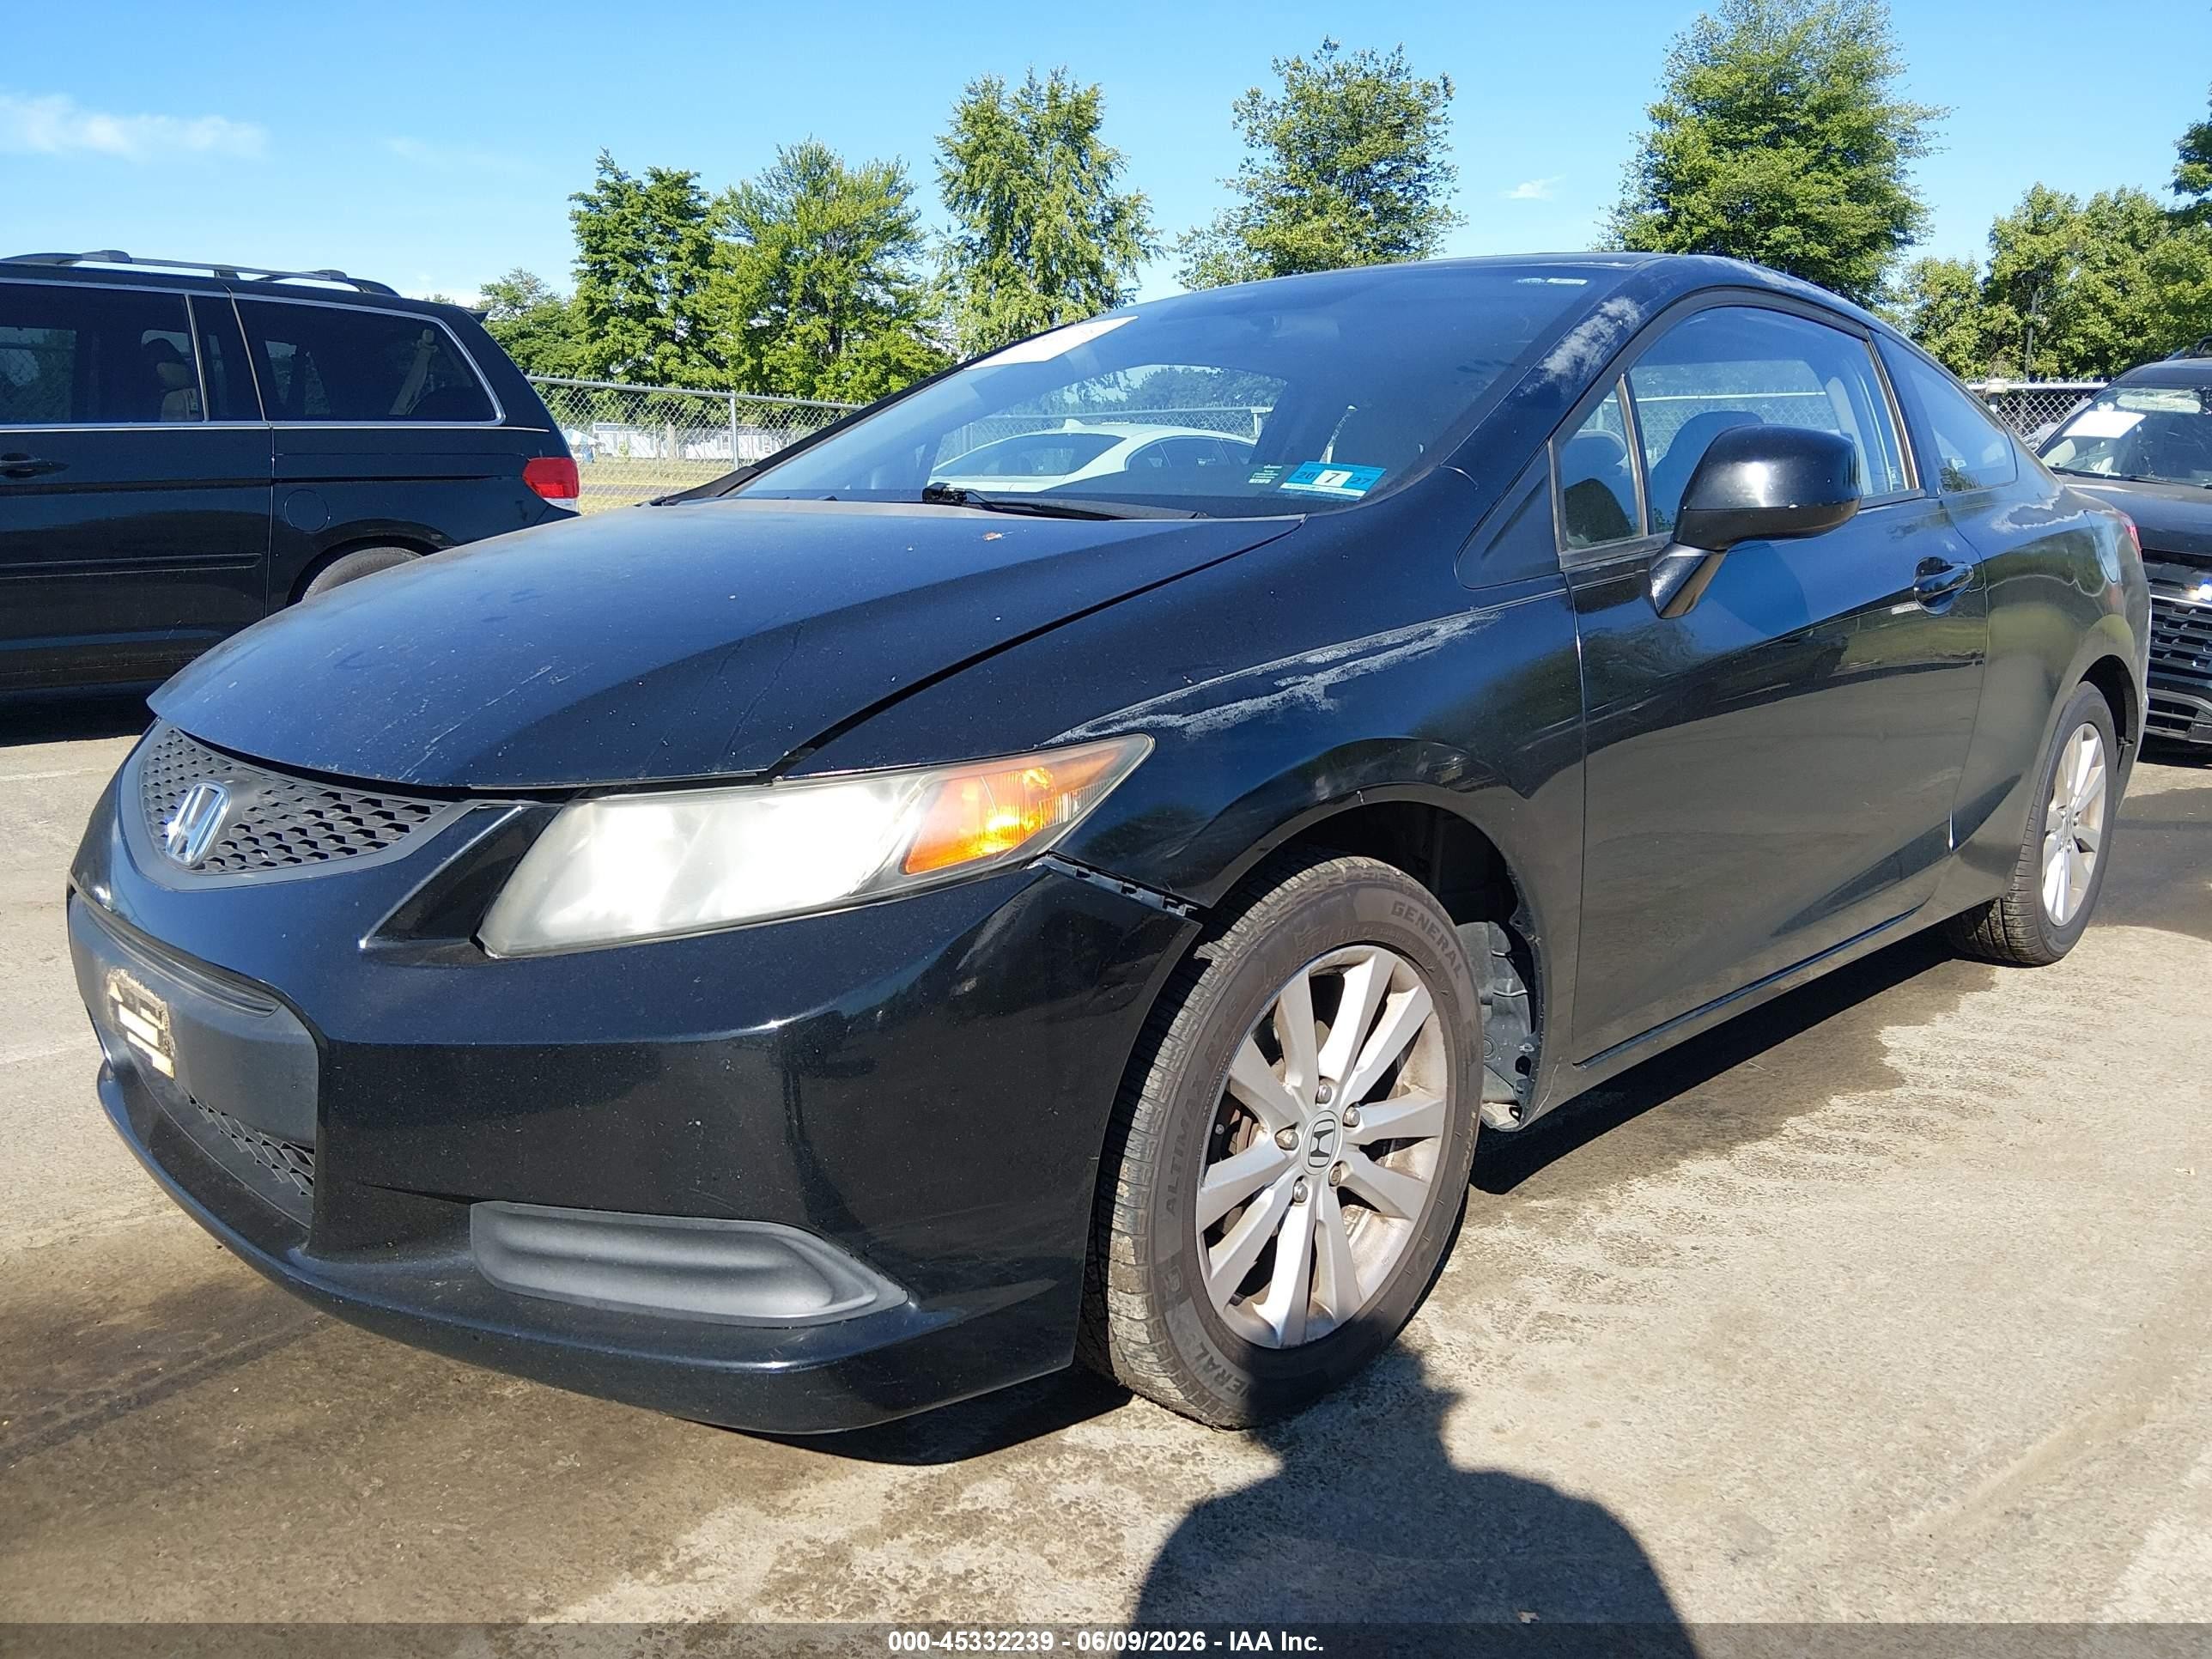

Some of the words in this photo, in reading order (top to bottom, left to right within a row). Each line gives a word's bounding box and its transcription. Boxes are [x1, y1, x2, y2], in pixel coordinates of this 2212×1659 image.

[1297, 471, 1315, 480] 20
[1325, 472, 1340, 483] 7
[1350, 477, 1371, 485] 27
[1391, 900, 1466, 979] GENERAL
[1165, 1072, 1204, 1218] ALTIMAX
